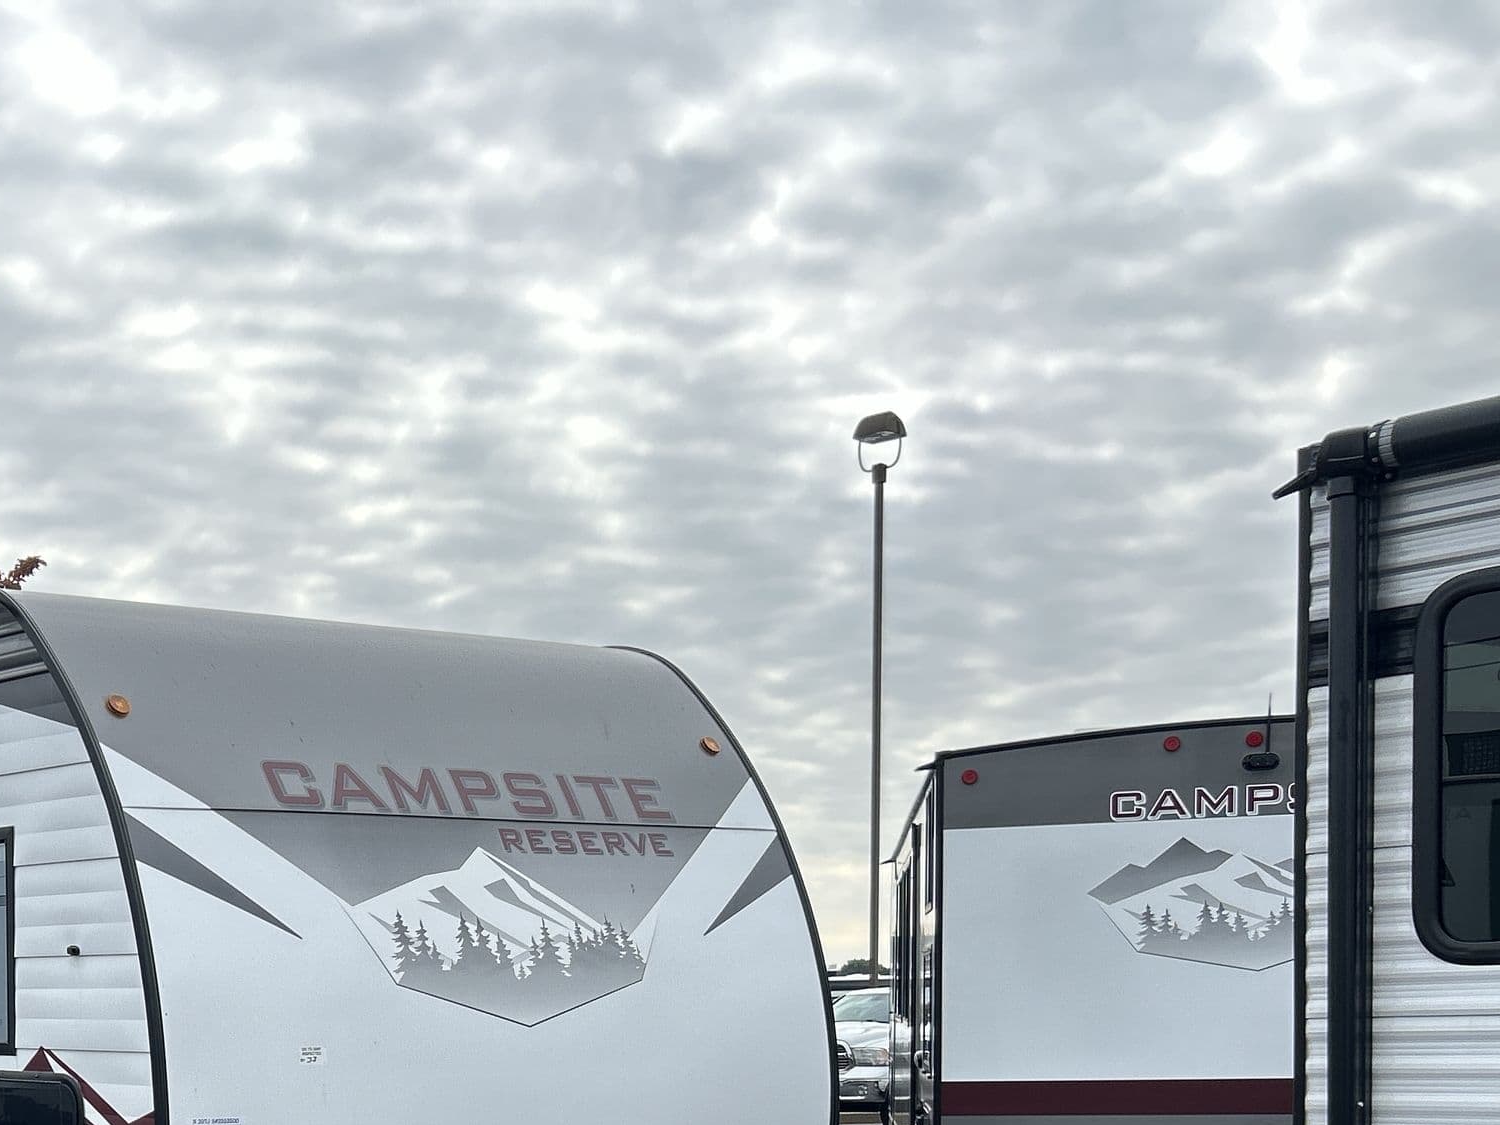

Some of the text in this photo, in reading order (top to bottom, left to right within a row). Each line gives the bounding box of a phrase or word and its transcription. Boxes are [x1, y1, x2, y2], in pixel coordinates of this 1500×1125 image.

[261, 759, 679, 824] CAMPSITE
[1109, 783, 1296, 822] CAMP
[498, 827, 677, 858] RESERVE
